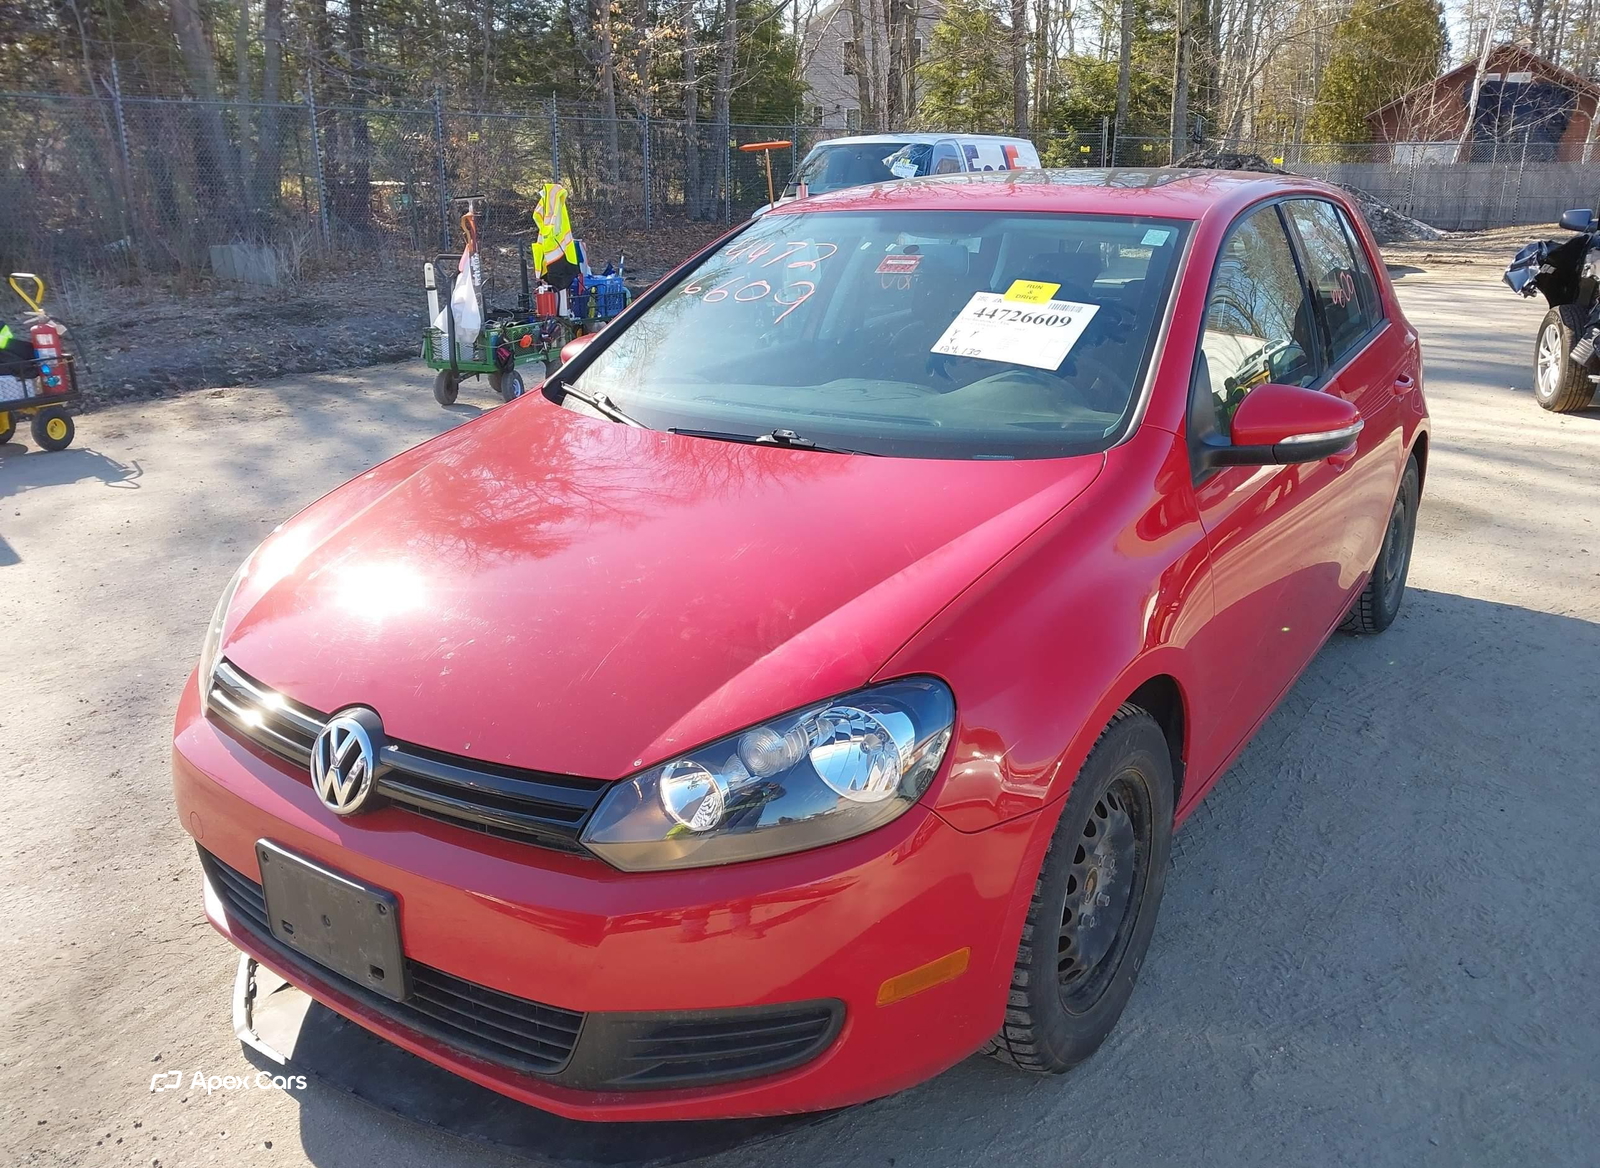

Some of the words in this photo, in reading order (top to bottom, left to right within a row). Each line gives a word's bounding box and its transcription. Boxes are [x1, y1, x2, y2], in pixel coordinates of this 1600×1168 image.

[725, 237, 838, 272] 4472
[679, 272, 815, 324] 6609
[973, 306, 1072, 328] 44726609
